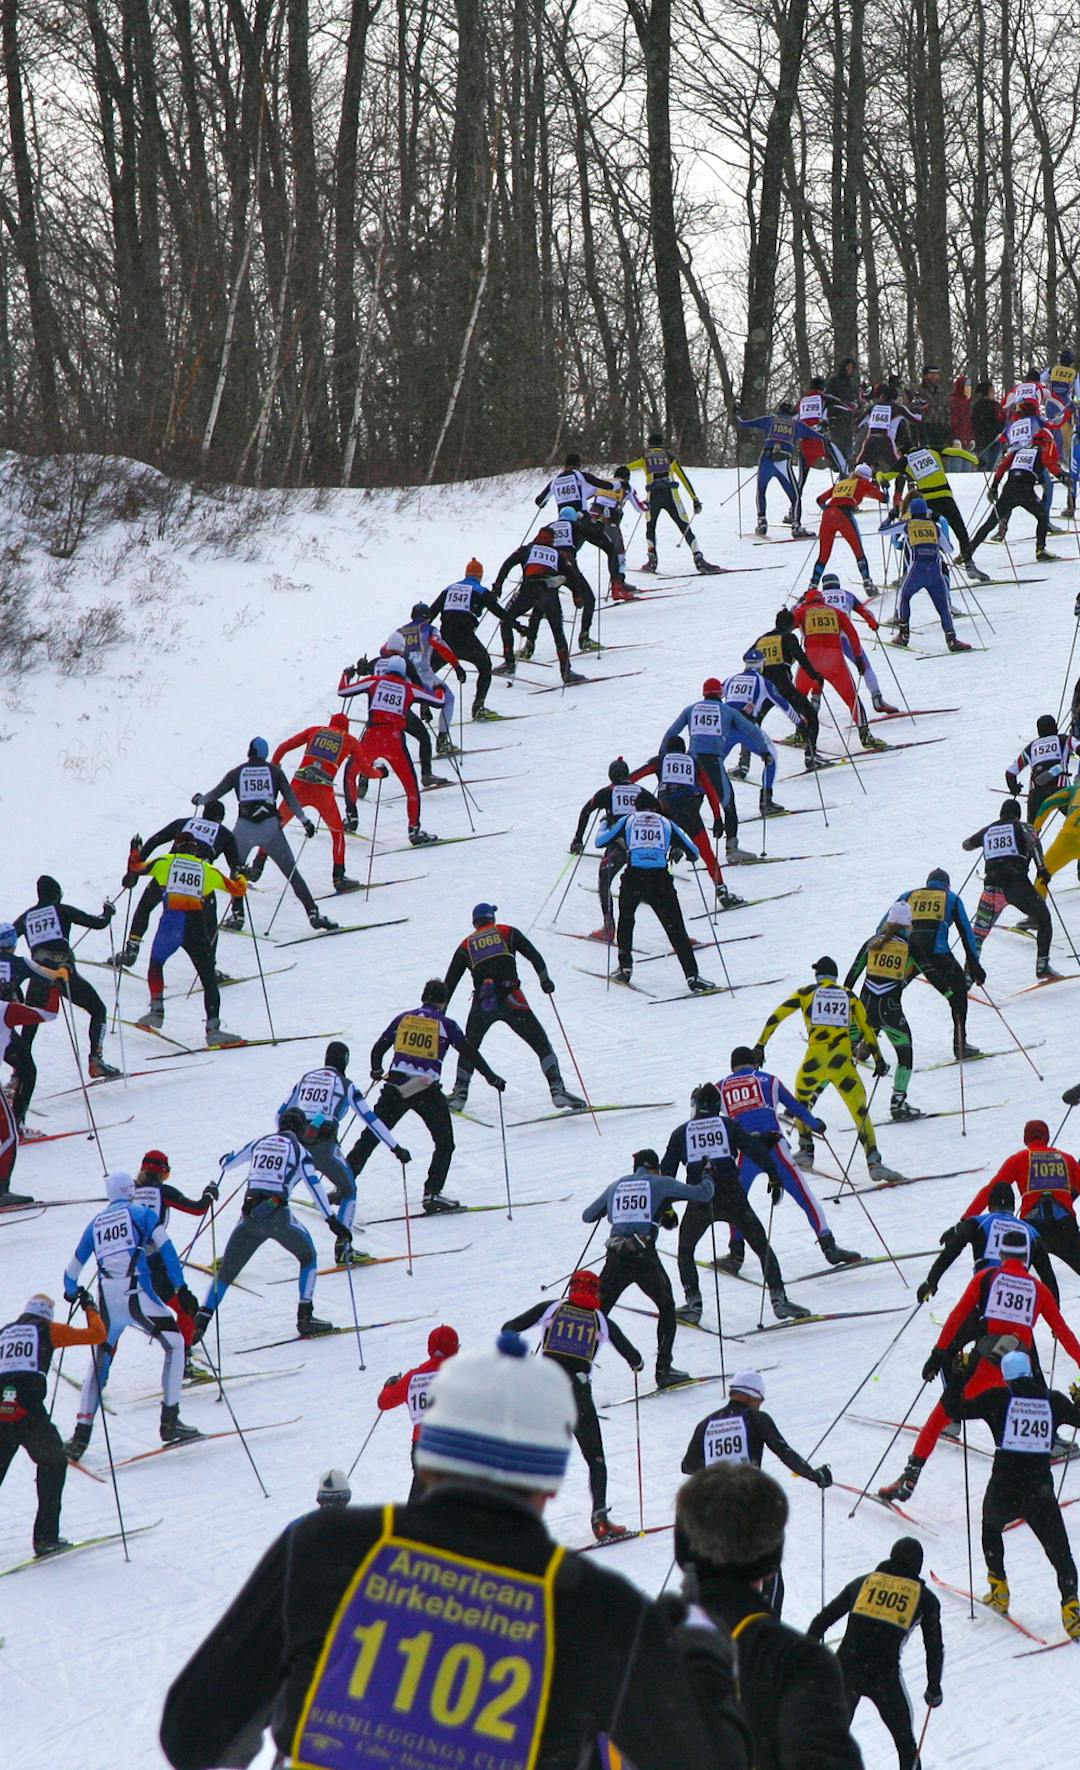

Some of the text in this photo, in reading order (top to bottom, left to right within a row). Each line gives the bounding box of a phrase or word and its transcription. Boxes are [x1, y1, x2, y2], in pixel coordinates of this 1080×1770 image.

[554, 529, 569, 539] 553
[763, 647, 776, 657] 819
[616, 794, 636, 805] 166
[988, 836, 1012, 850] 1383
[28, 918, 55, 933] 1577
[872, 953, 901, 970] 1869
[402, 1031, 432, 1048] 1906
[300, 1087, 327, 1102] 1503
[691, 1132, 724, 1148] 1599
[252, 1155, 282, 1169] 1269
[615, 1196, 647, 1210] 1550
[96, 1223, 128, 1241] 1405
[996, 1291, 1033, 1312] 1381
[557, 1321, 594, 1342] 1111
[0, 1342, 33, 1358] 1260
[1011, 1418, 1049, 1438] 1249
[708, 1435, 742, 1457] 1569
[388, 1550, 534, 1611] American
[365, 1573, 540, 1642] Birkebeiner
[866, 1588, 908, 1611] 1905
[348, 1619, 532, 1743] 1102
